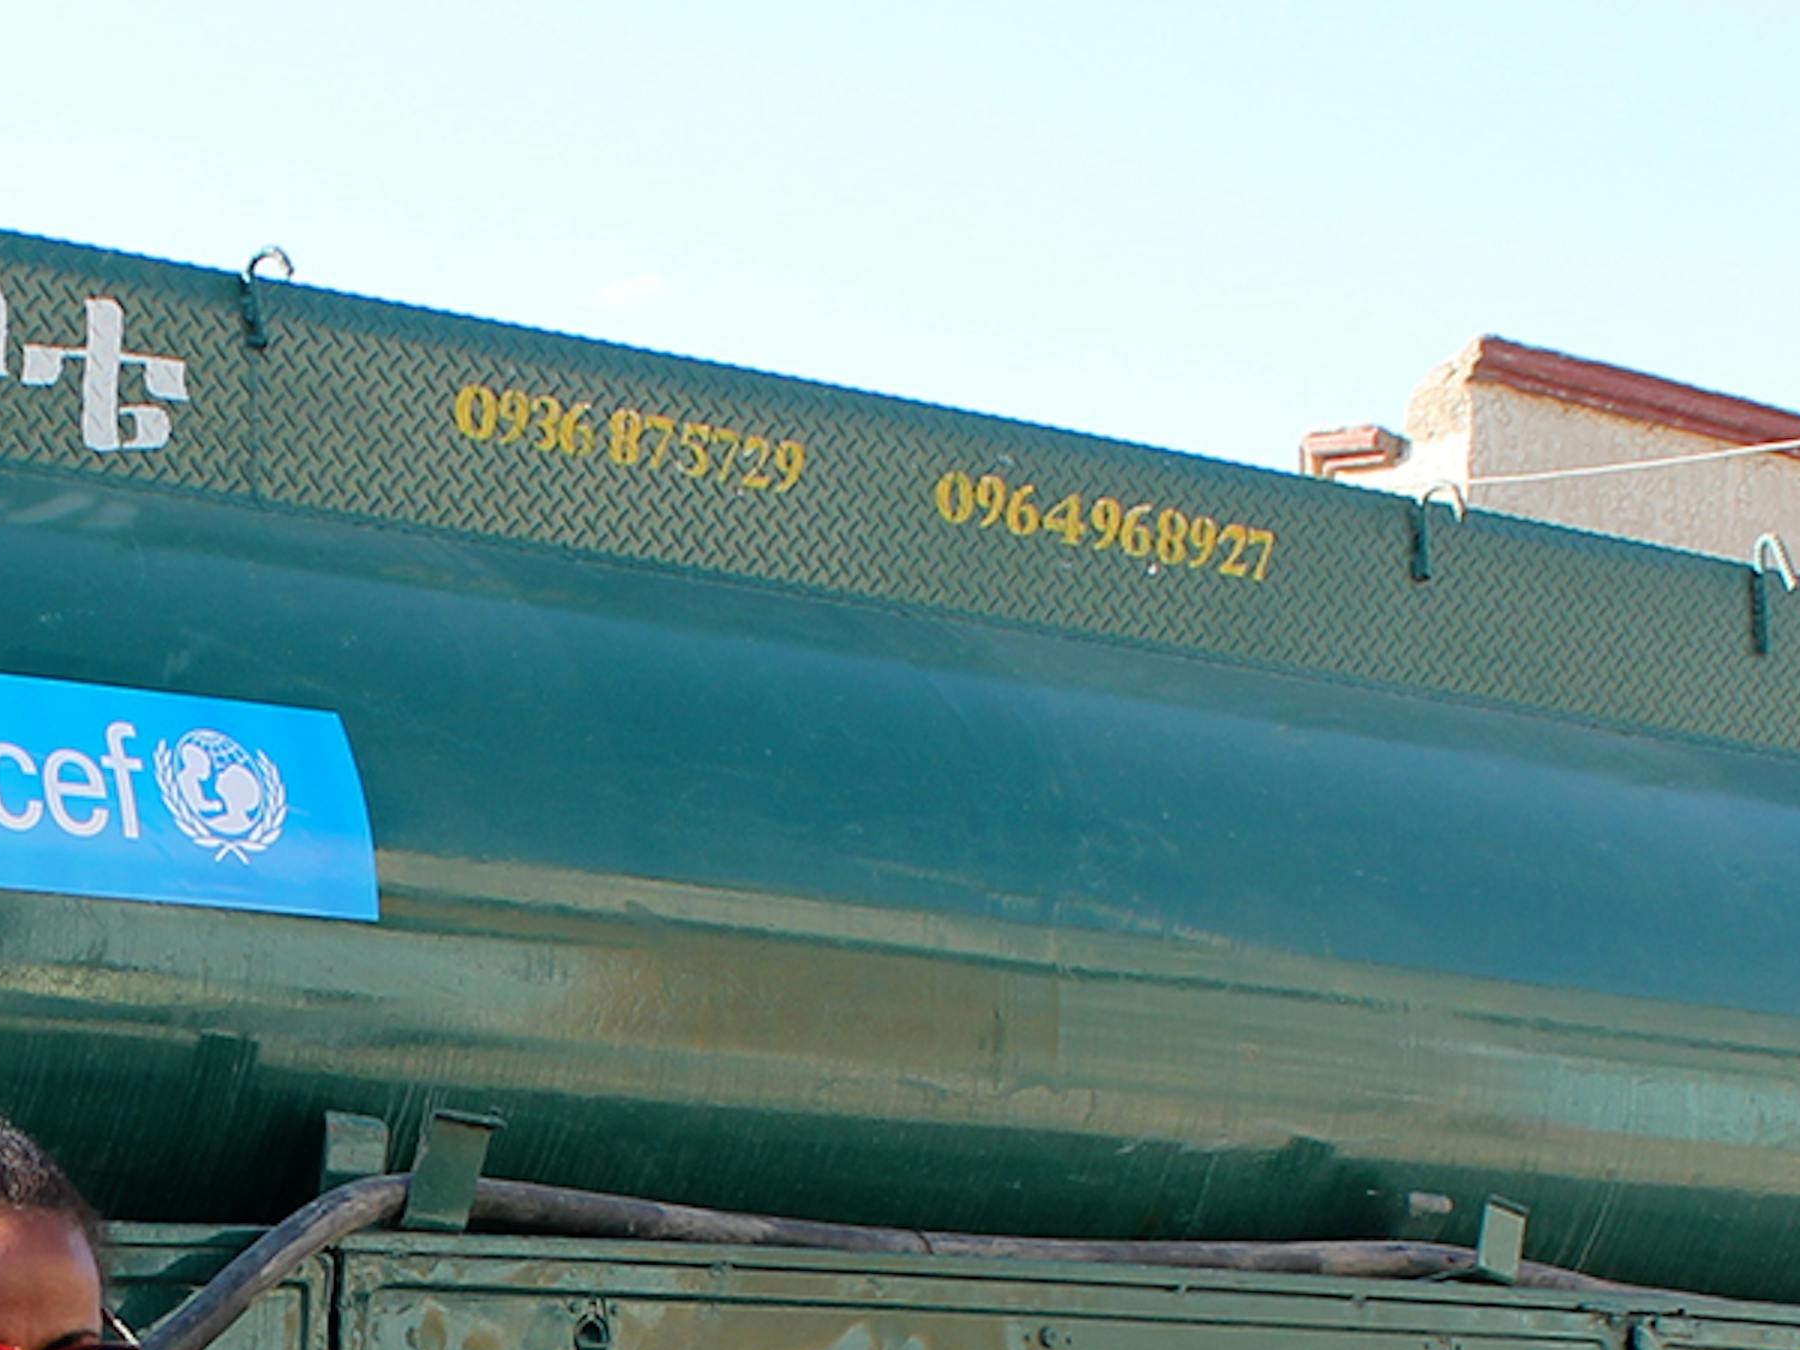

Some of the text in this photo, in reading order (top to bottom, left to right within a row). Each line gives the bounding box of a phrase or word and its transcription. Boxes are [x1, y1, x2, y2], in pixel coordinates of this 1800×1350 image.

[454, 384, 805, 493] 0936 875729
[934, 470, 1277, 582] 0964968927
